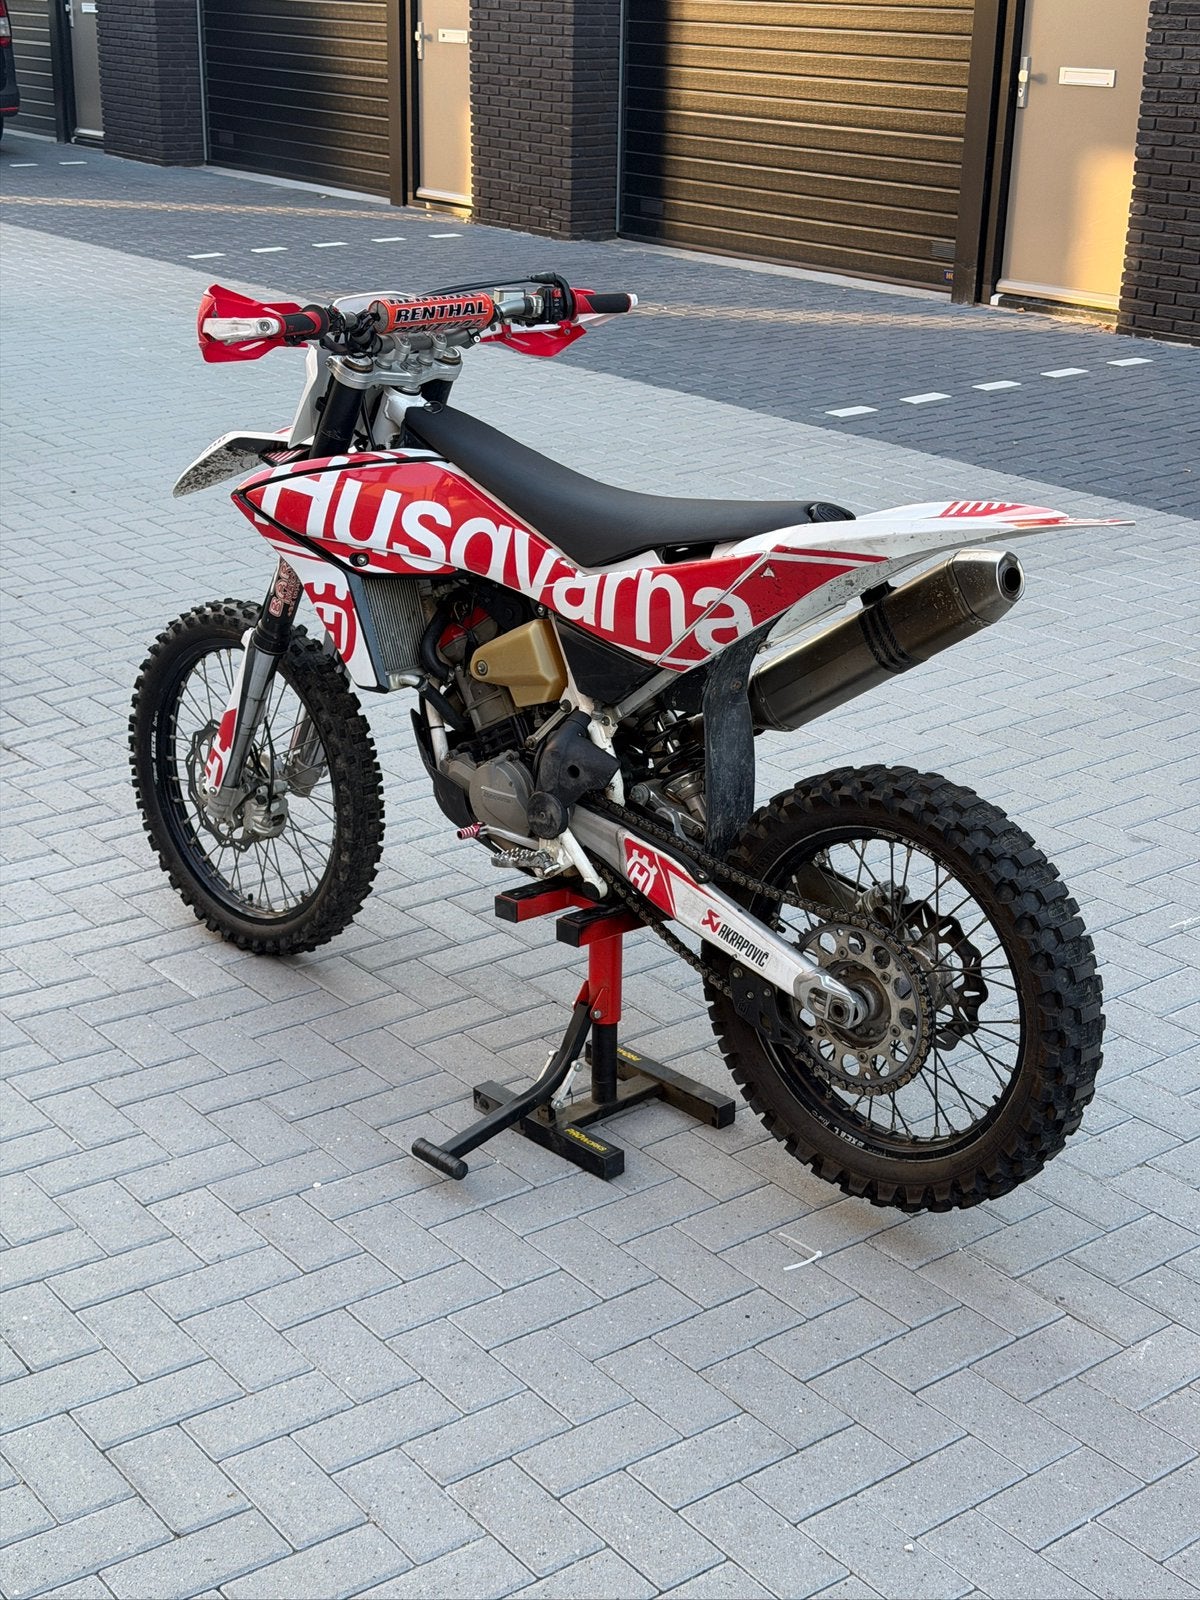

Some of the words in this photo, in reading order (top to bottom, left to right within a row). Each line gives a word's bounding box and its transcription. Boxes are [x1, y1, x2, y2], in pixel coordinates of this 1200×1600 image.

[394, 301, 488, 323] RENTHAL
[254, 455, 754, 655] Husqvarna
[717, 924, 770, 967] AKRAPOVIČ
